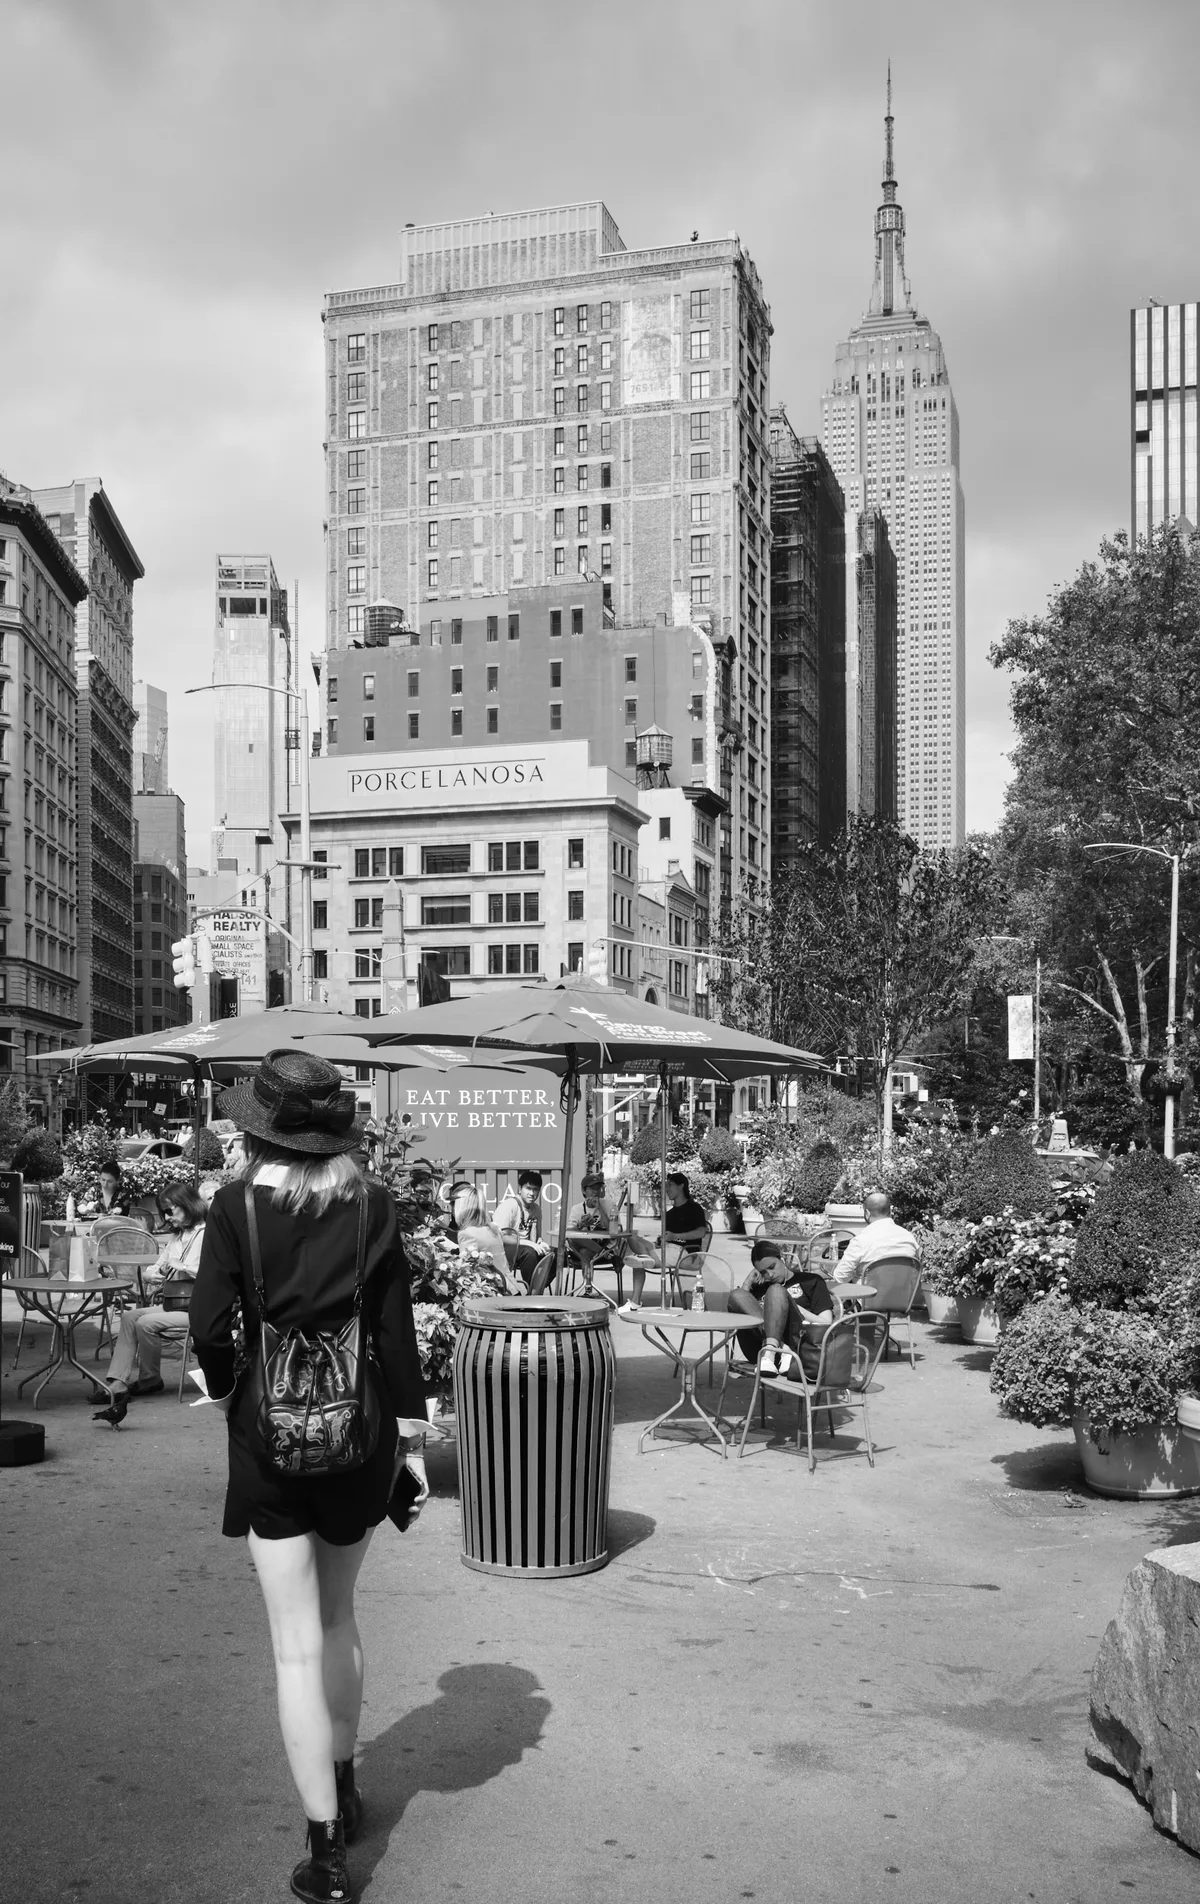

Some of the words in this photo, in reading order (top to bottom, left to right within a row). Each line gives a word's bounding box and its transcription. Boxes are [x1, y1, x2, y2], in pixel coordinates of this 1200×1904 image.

[351, 764, 544, 793] PORCELANOSA
[213, 921, 261, 931] REALTY
[233, 943, 254, 951] SPACE
[406, 1089, 451, 1105] EAT
[458, 1089, 555, 1107] BETTER,
[468, 1112, 557, 1128] BETTER
